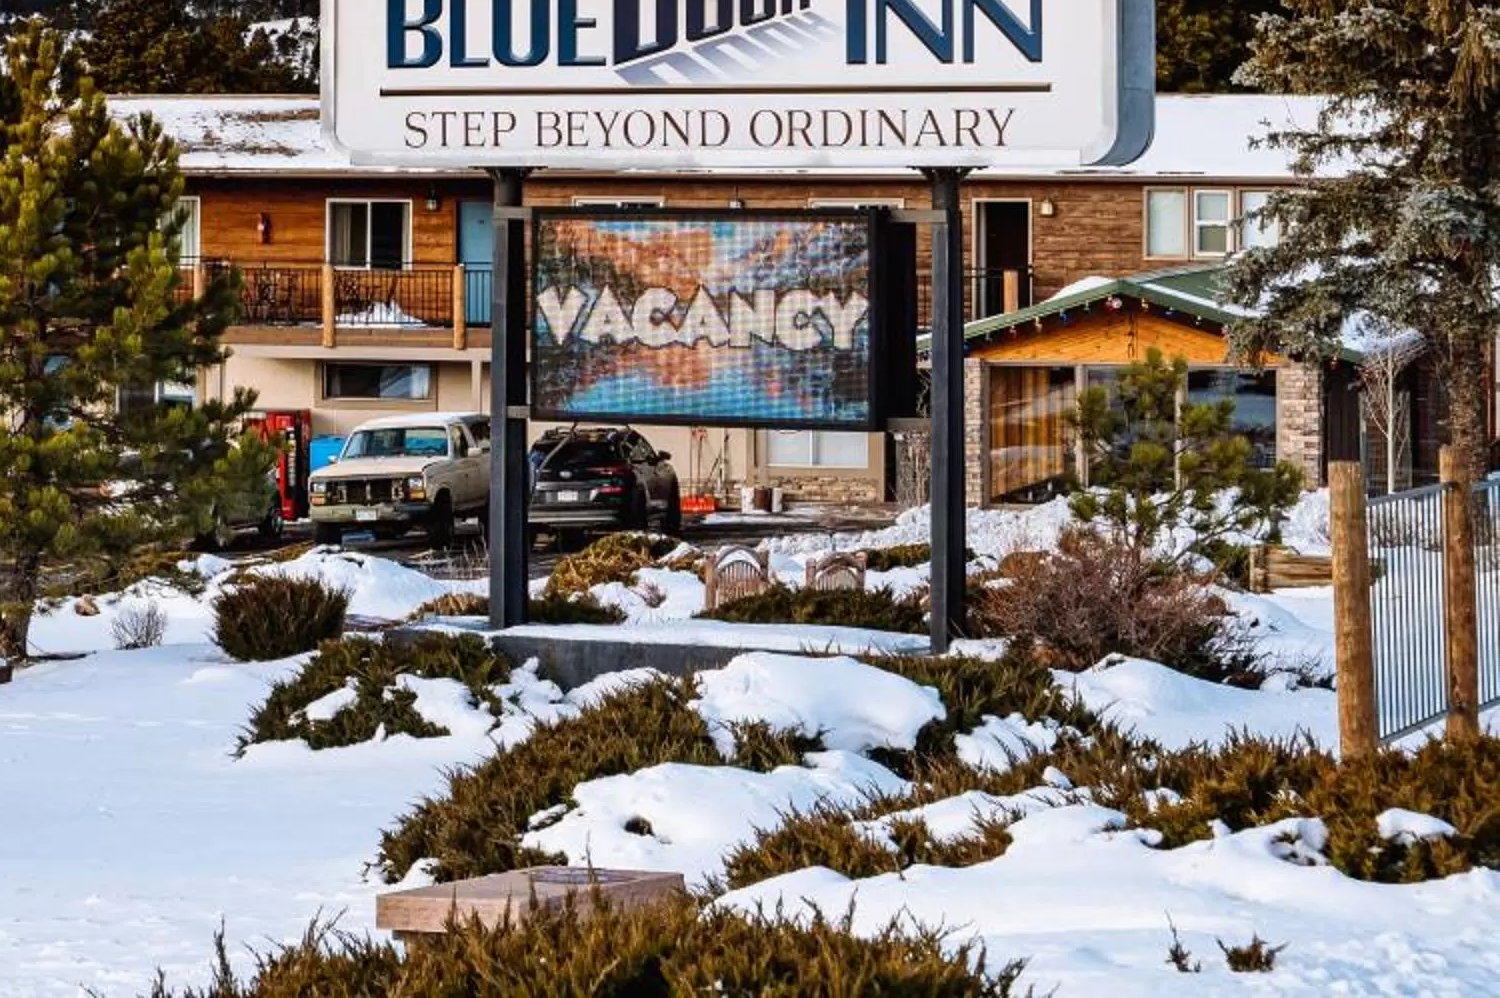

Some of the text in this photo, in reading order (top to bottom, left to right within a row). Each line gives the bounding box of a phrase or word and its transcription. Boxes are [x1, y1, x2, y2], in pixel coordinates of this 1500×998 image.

[403, 107, 1016, 149] STEP BEYOND ORDINARY
[536, 282, 870, 351] VACANCY
